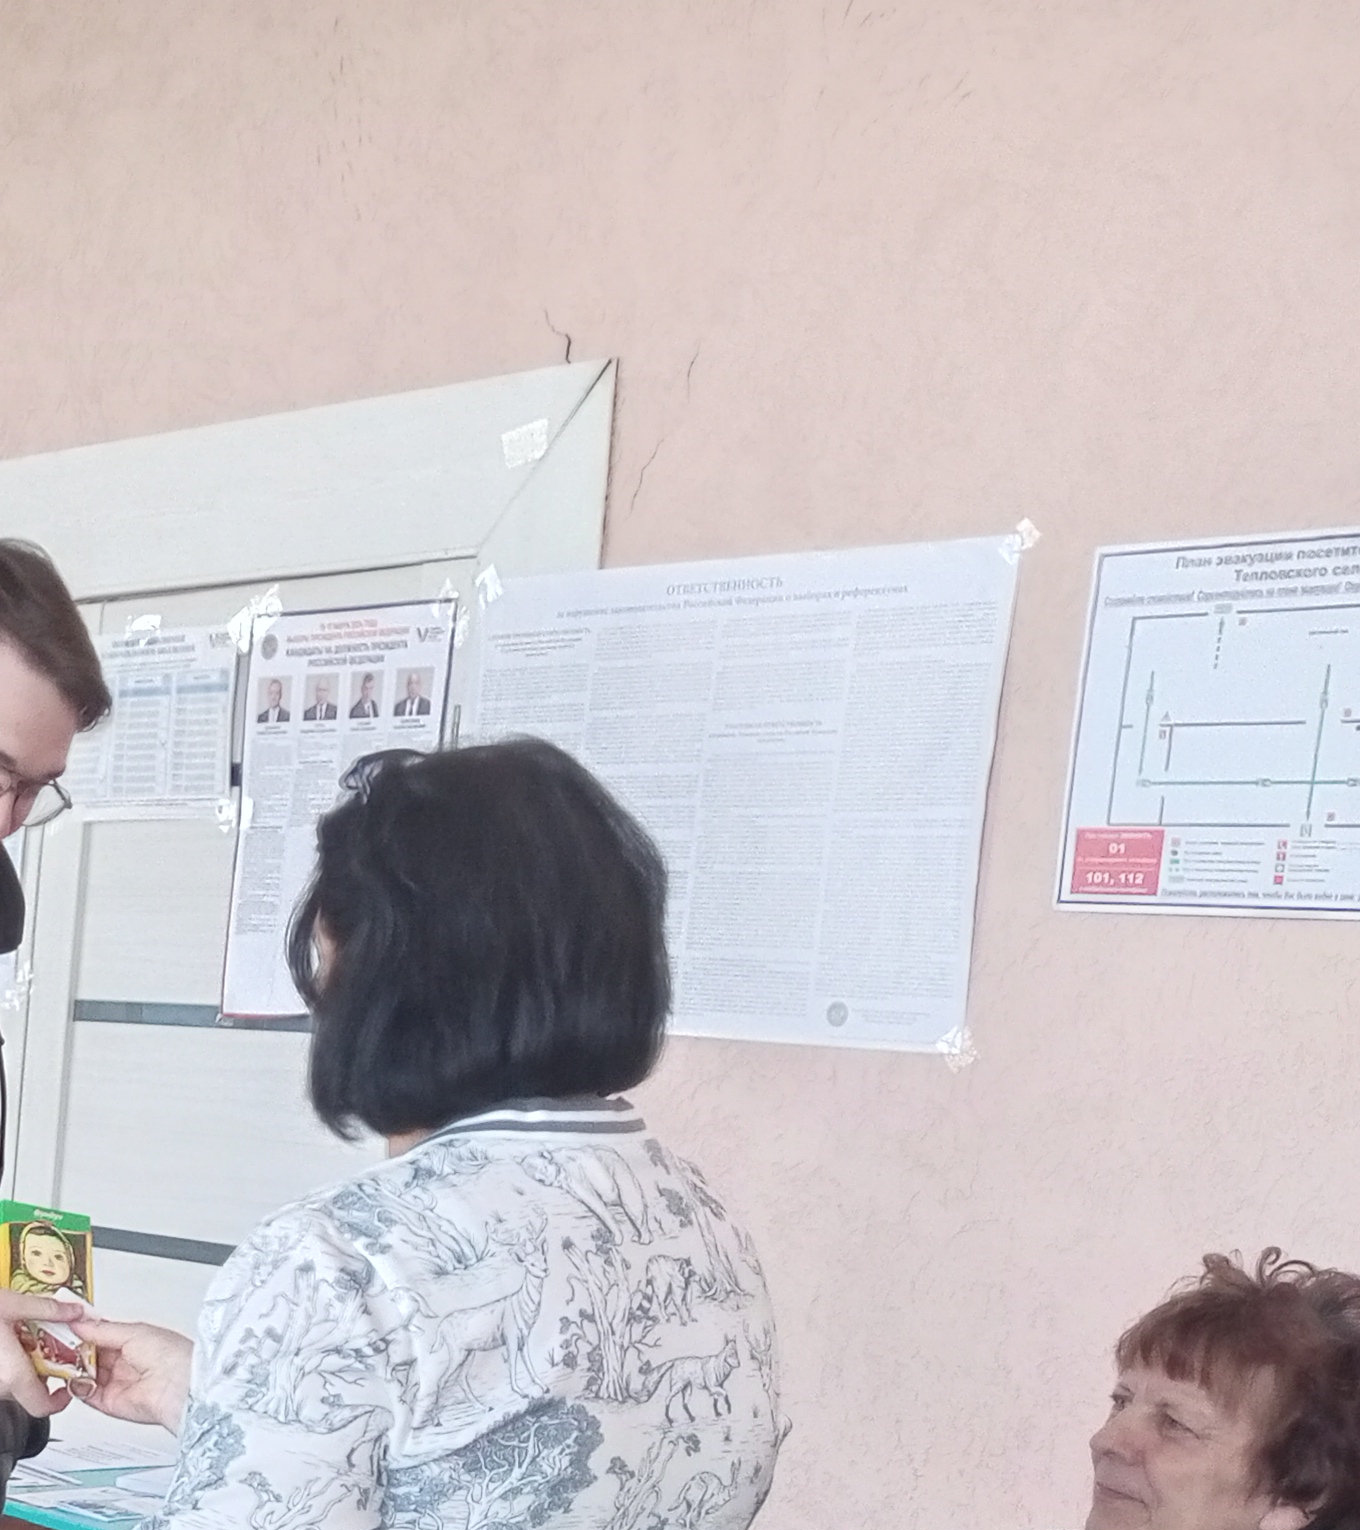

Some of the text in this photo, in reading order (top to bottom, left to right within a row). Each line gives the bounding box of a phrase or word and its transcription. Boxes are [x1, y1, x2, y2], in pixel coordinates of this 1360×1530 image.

[1176, 546, 1360, 569] План эвакуации посетит
[1234, 566, 1328, 582] Тепловского
[666, 576, 783, 596] ОТВЕТСТВЕННОСТЬ
[1108, 842, 1126, 855] 01
[1086, 871, 1144, 886] 101, 112
